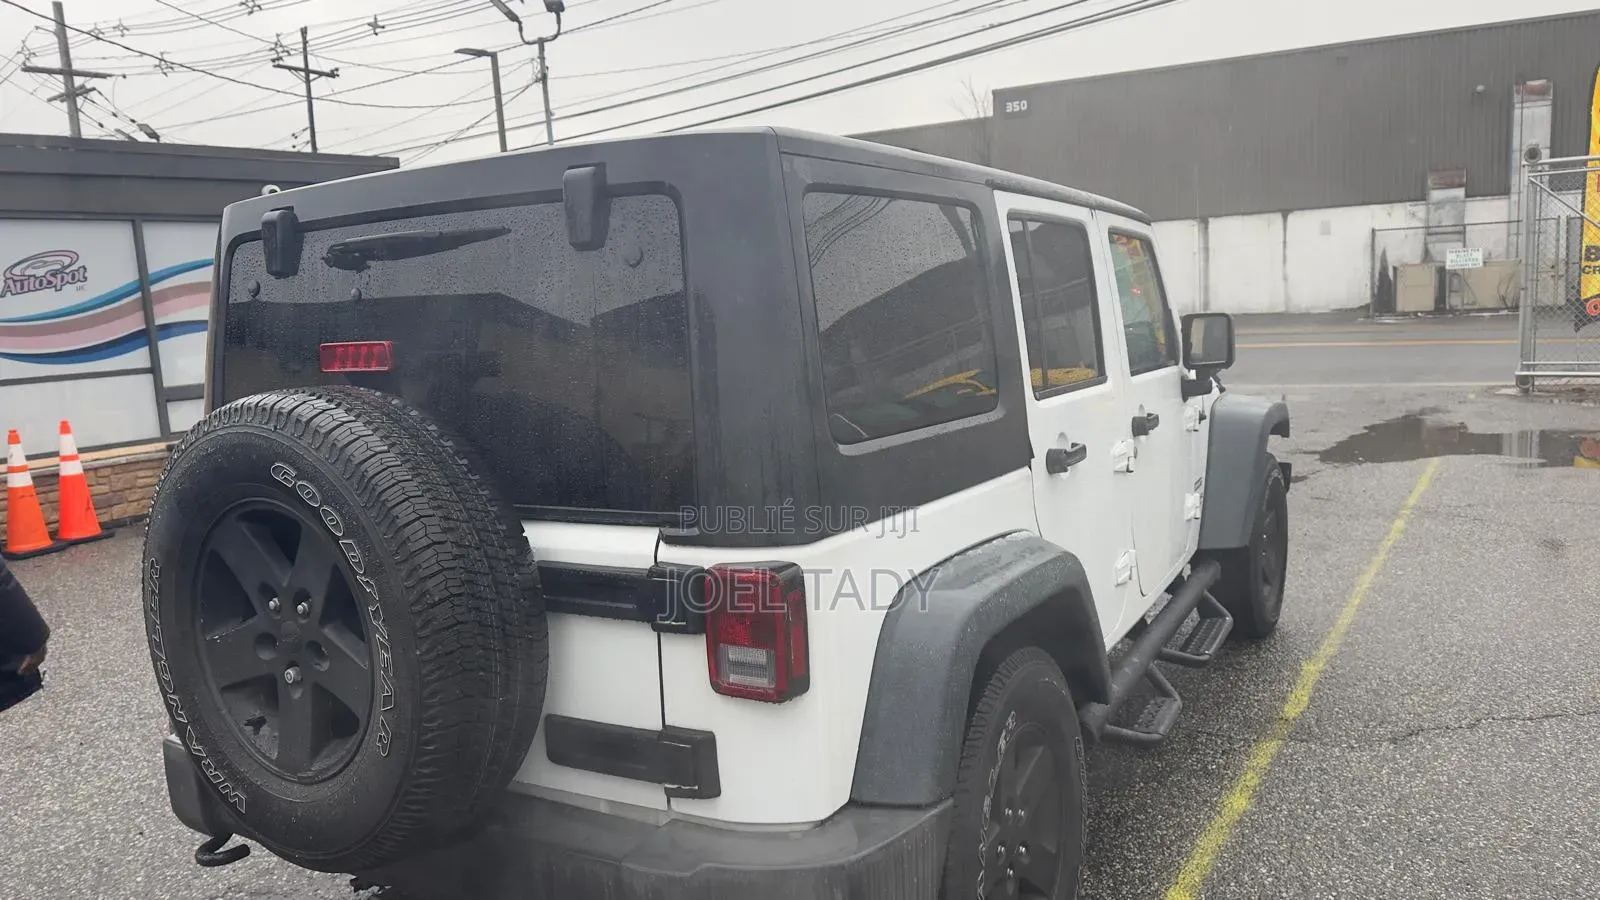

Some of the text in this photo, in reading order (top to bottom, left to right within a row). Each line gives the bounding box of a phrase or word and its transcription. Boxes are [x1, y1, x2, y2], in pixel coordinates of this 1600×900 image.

[1005, 100, 1028, 113] 350
[0, 265, 88, 298] AutoSpot
[147, 557, 247, 815] WRANGLER
